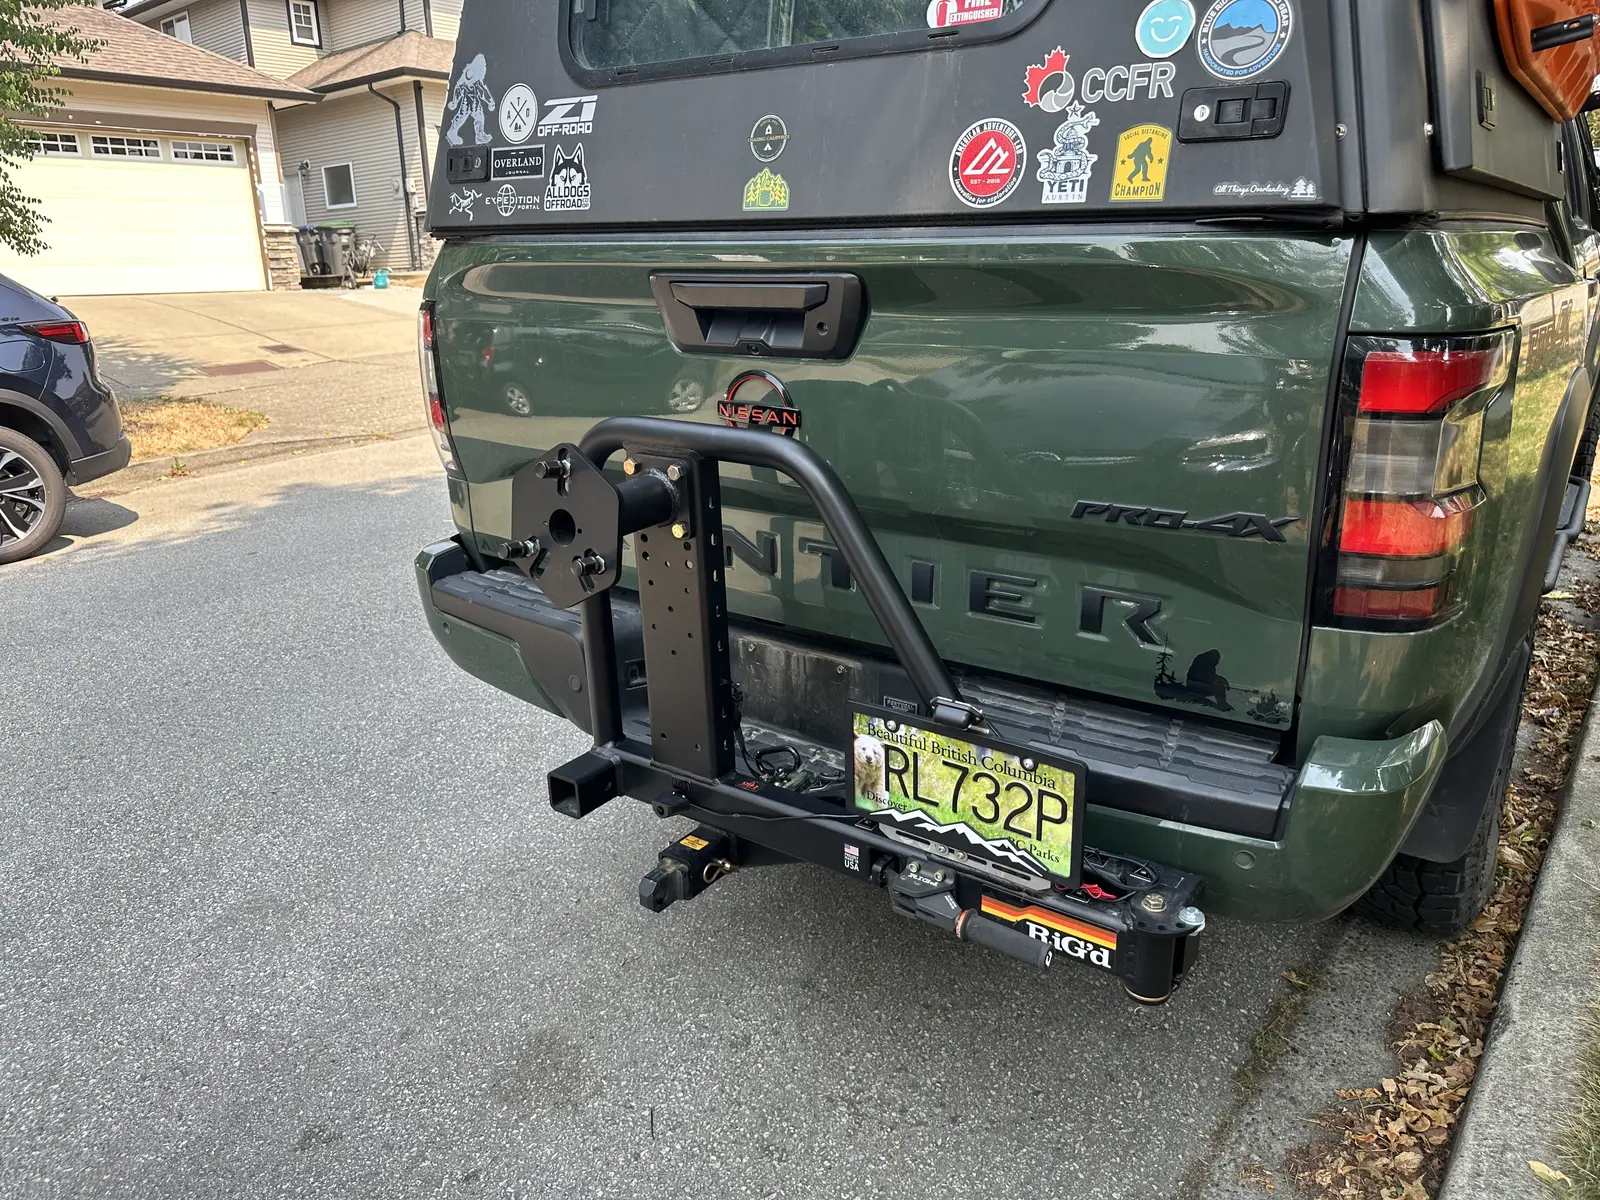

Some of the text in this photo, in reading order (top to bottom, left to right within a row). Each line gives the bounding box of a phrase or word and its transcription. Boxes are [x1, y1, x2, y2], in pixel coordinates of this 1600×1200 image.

[949, 8, 999, 23] EXTINGUISHER
[1202, 11, 1216, 33] BLUE
[1278, 3, 1289, 27] GEAR
[1202, 47, 1234, 76] HANDCRAFTED
[1248, 43, 1281, 73] ADVENTURE
[1081, 61, 1176, 103] CCFR
[955, 121, 1024, 157] AMERICAN ADVENTURE LAB
[1123, 128, 1168, 141] SOCIAL DISTANCING
[494, 156, 542, 168] OVERLAND
[546, 185, 589, 199] ALLDOGS
[976, 197, 986, 205] for
[986, 176, 1017, 203] exploration
[1046, 179, 1085, 193] YETI
[1114, 182, 1161, 197] CHAMPION
[1214, 184, 1290, 196] All Things Overlanding
[485, 195, 540, 205] EXPEDITION
[545, 198, 582, 210] OFFROAD
[1044, 193, 1083, 202] AUSTIN
[719, 403, 797, 425] NISSAN
[1070, 500, 1301, 543] PRO-4X
[867, 722, 1056, 790] Beautiful British Columbia
[866, 790, 908, 812] Discover
[884, 744, 1068, 842] RL732P
[1029, 844, 1060, 864] Parks
[844, 859, 860, 872] USA
